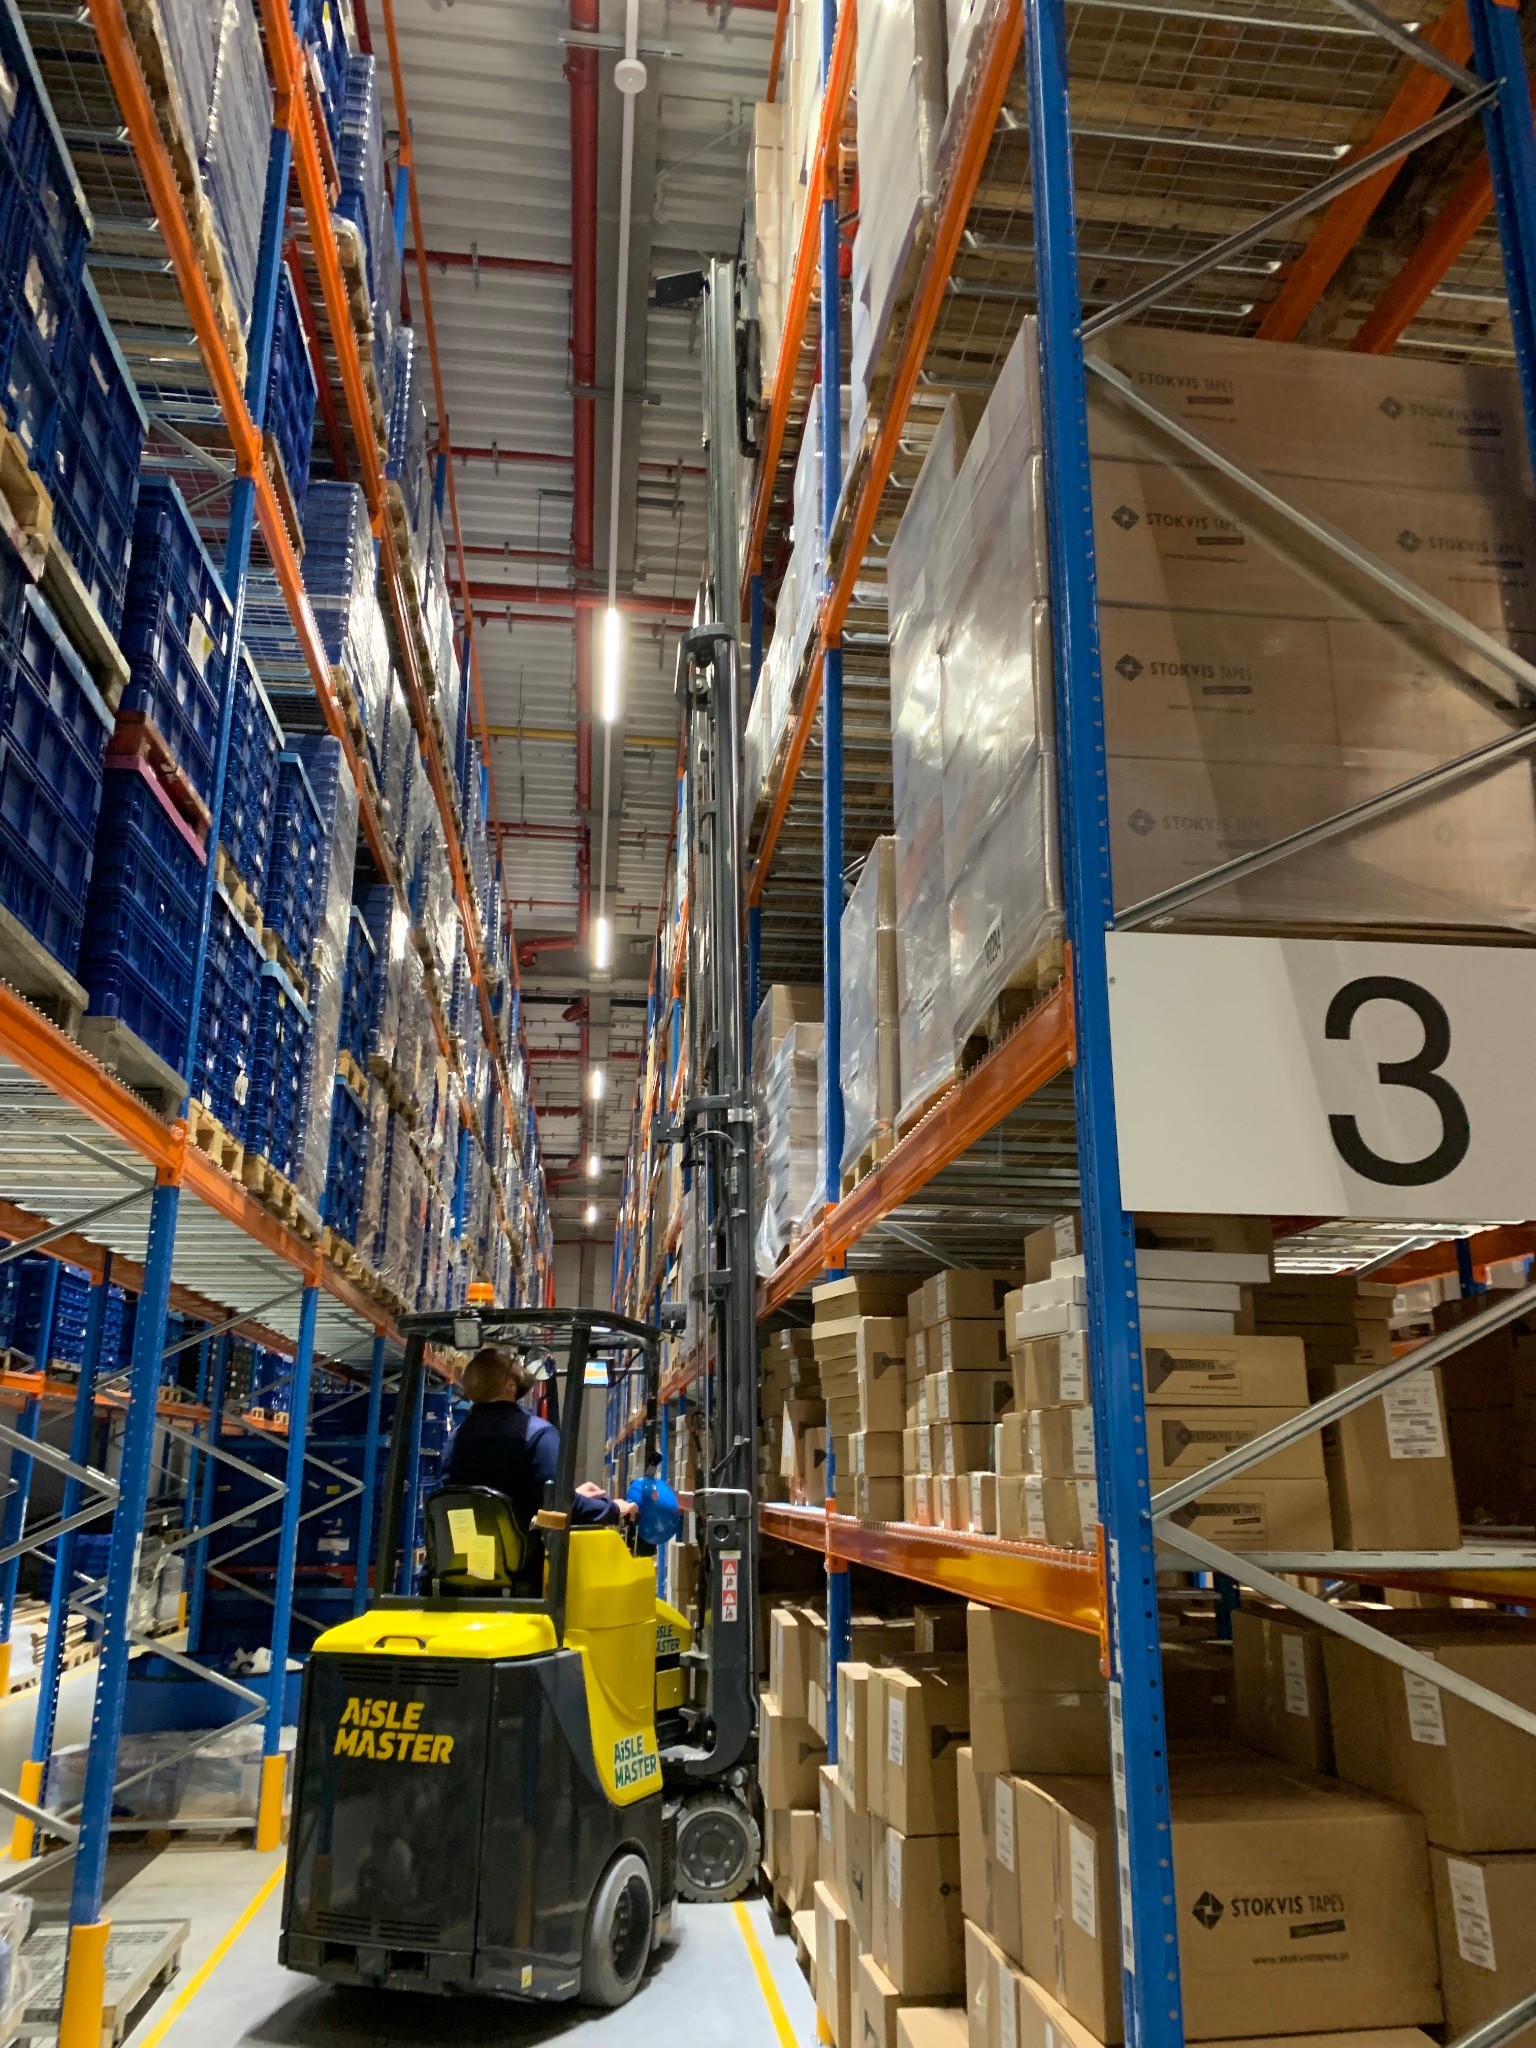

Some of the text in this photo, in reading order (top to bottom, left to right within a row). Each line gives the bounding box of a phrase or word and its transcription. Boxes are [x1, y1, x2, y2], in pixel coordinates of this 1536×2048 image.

[1137, 372, 1199, 390] STOKVIS
[1146, 512, 1209, 530] STOKVIS
[1150, 661, 1253, 682] STOKVIS TAPES
[1325, 975, 1471, 1188] 3
[333, 1728, 455, 1764] MASTER
[614, 1753, 658, 1790] MASTER
[1231, 1893, 1346, 1917] STOKVIS TAPES
